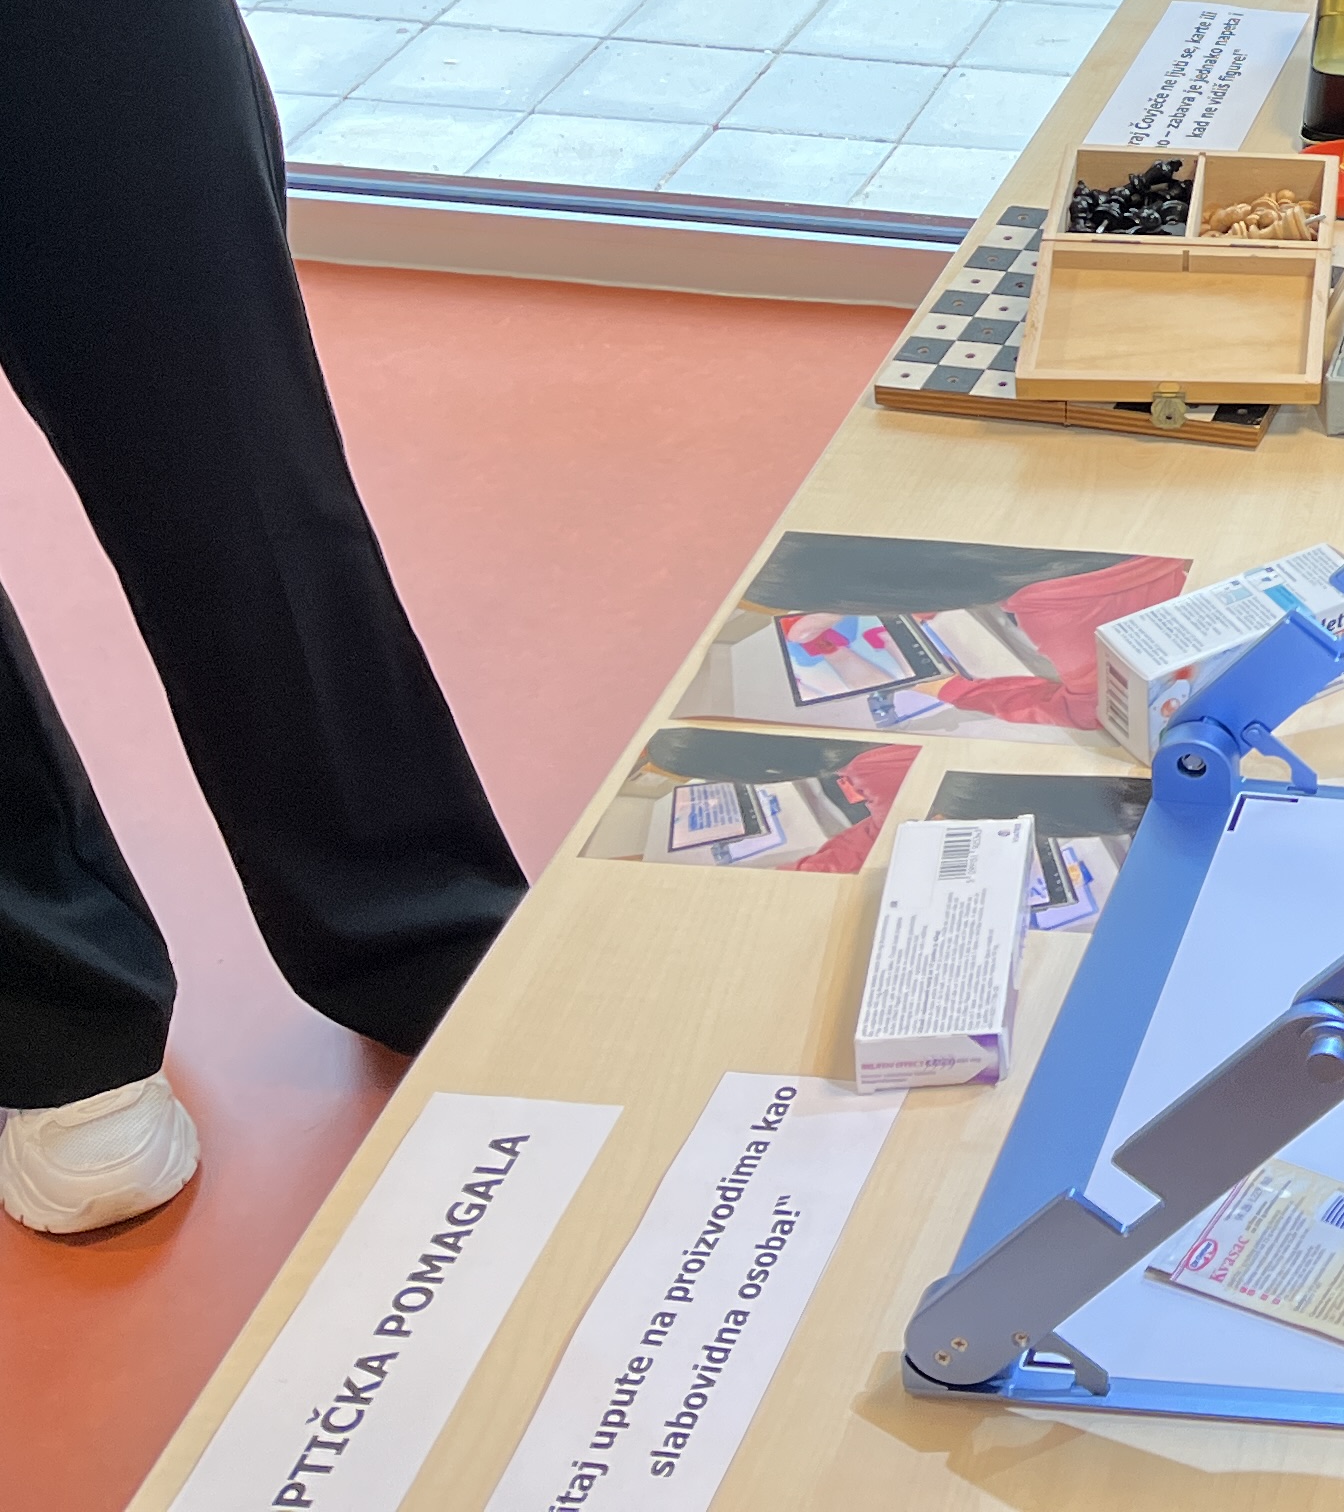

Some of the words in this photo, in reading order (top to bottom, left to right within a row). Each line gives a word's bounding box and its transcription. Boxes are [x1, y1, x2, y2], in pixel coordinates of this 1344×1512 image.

[1199, 10, 1218, 21] ili
[1184, 20, 1212, 44] karte
[1214, 18, 1242, 47] napeta
[1181, 46, 1200, 60] se,
[1164, 59, 1190, 78] ljuti
[1189, 47, 1224, 84] jednako
[1161, 78, 1178, 92] ne
[1182, 84, 1204, 95] je
[1206, 82, 1231, 105] vidiš
[1129, 92, 1170, 131] Čovječe
[1167, 95, 1196, 129] zabava
[1200, 106, 1219, 119] ne
[1128, 130, 1150, 146] raj
[1185, 120, 1210, 138] kad
[1209, 1235, 1250, 1283] Kvasac
[548, 1460, 609, 1512] itaj
[589, 1354, 655, 1451] upute
[640, 1306, 678, 1348] na
[664, 1132, 770, 1303] proizvodima
[749, 1084, 799, 1135] kao
[271, 1351, 400, 1509] PTIČKA
[373, 1133, 532, 1338] POMAGALA
[650, 1309, 752, 1479] slabovidna
